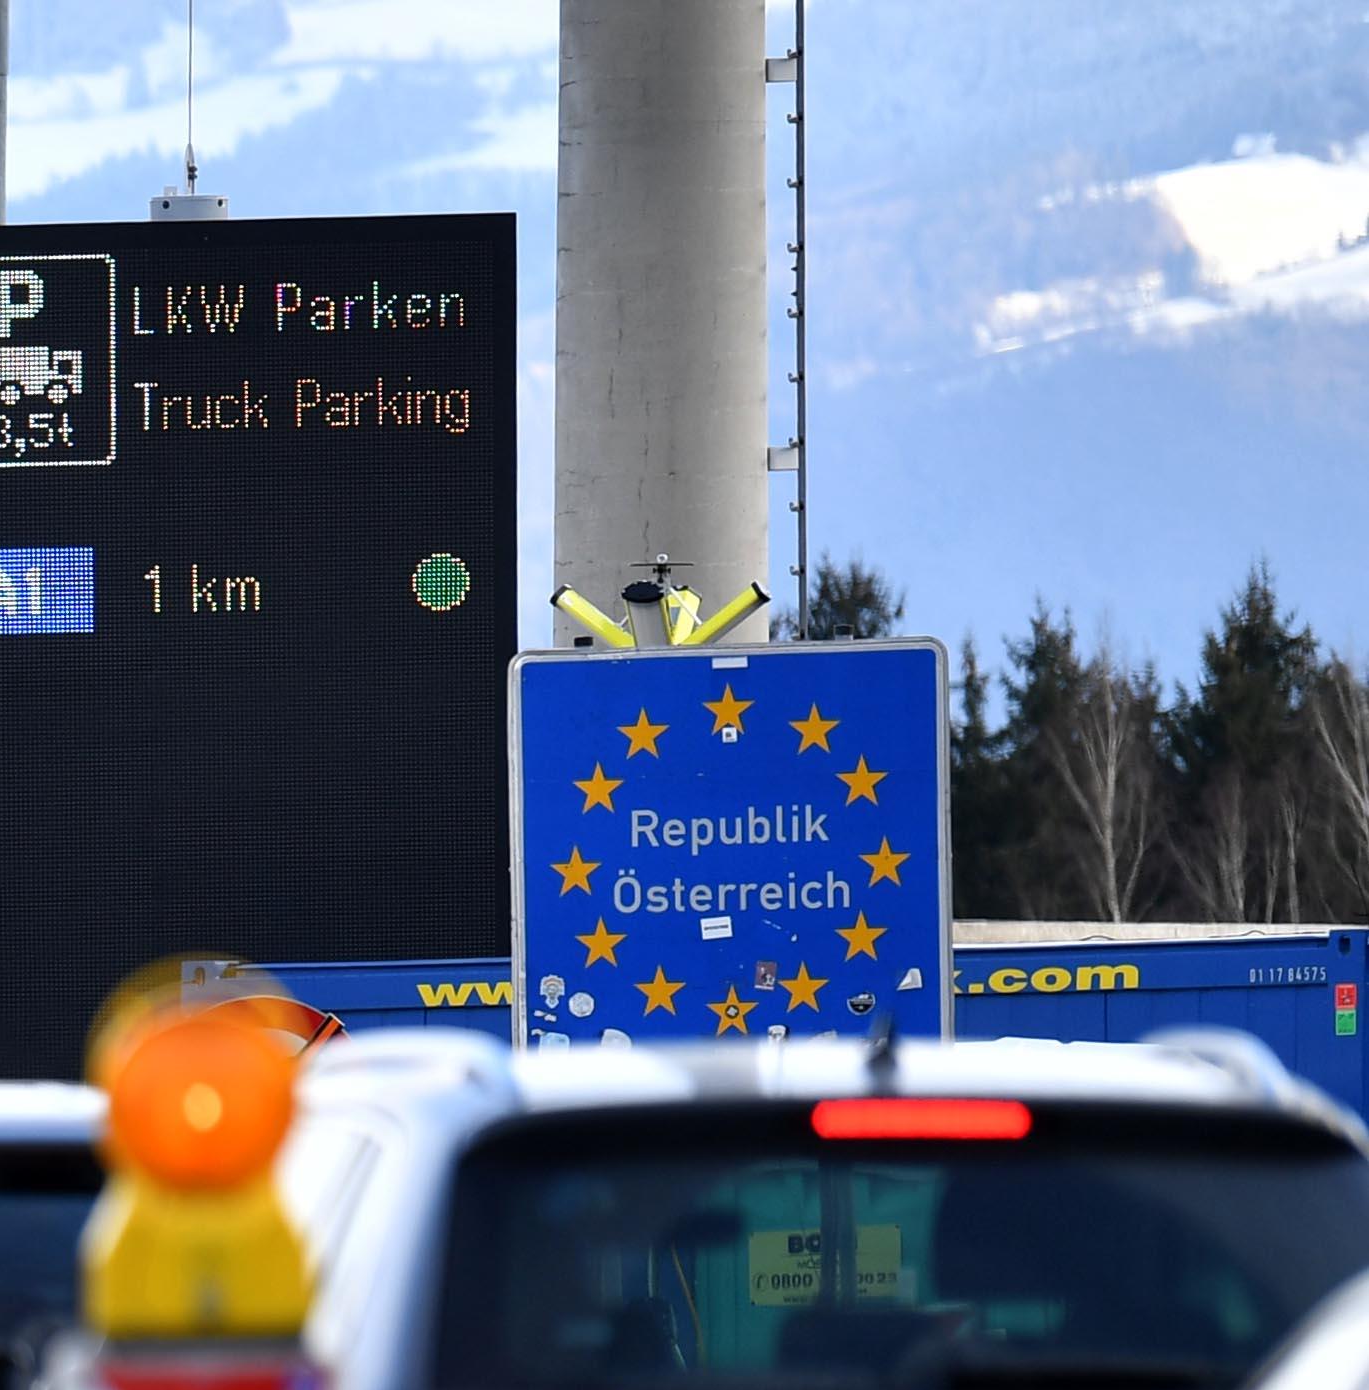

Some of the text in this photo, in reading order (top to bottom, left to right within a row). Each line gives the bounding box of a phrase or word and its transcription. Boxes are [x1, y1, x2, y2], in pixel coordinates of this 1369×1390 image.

[132, 281, 465, 335] LKW Parken
[134, 376, 471, 433] Truck Parking
[144, 564, 261, 613] 1 km
[630, 805, 830, 856] Republik
[612, 869, 851, 914] Österreich
[953, 963, 1140, 994] .com
